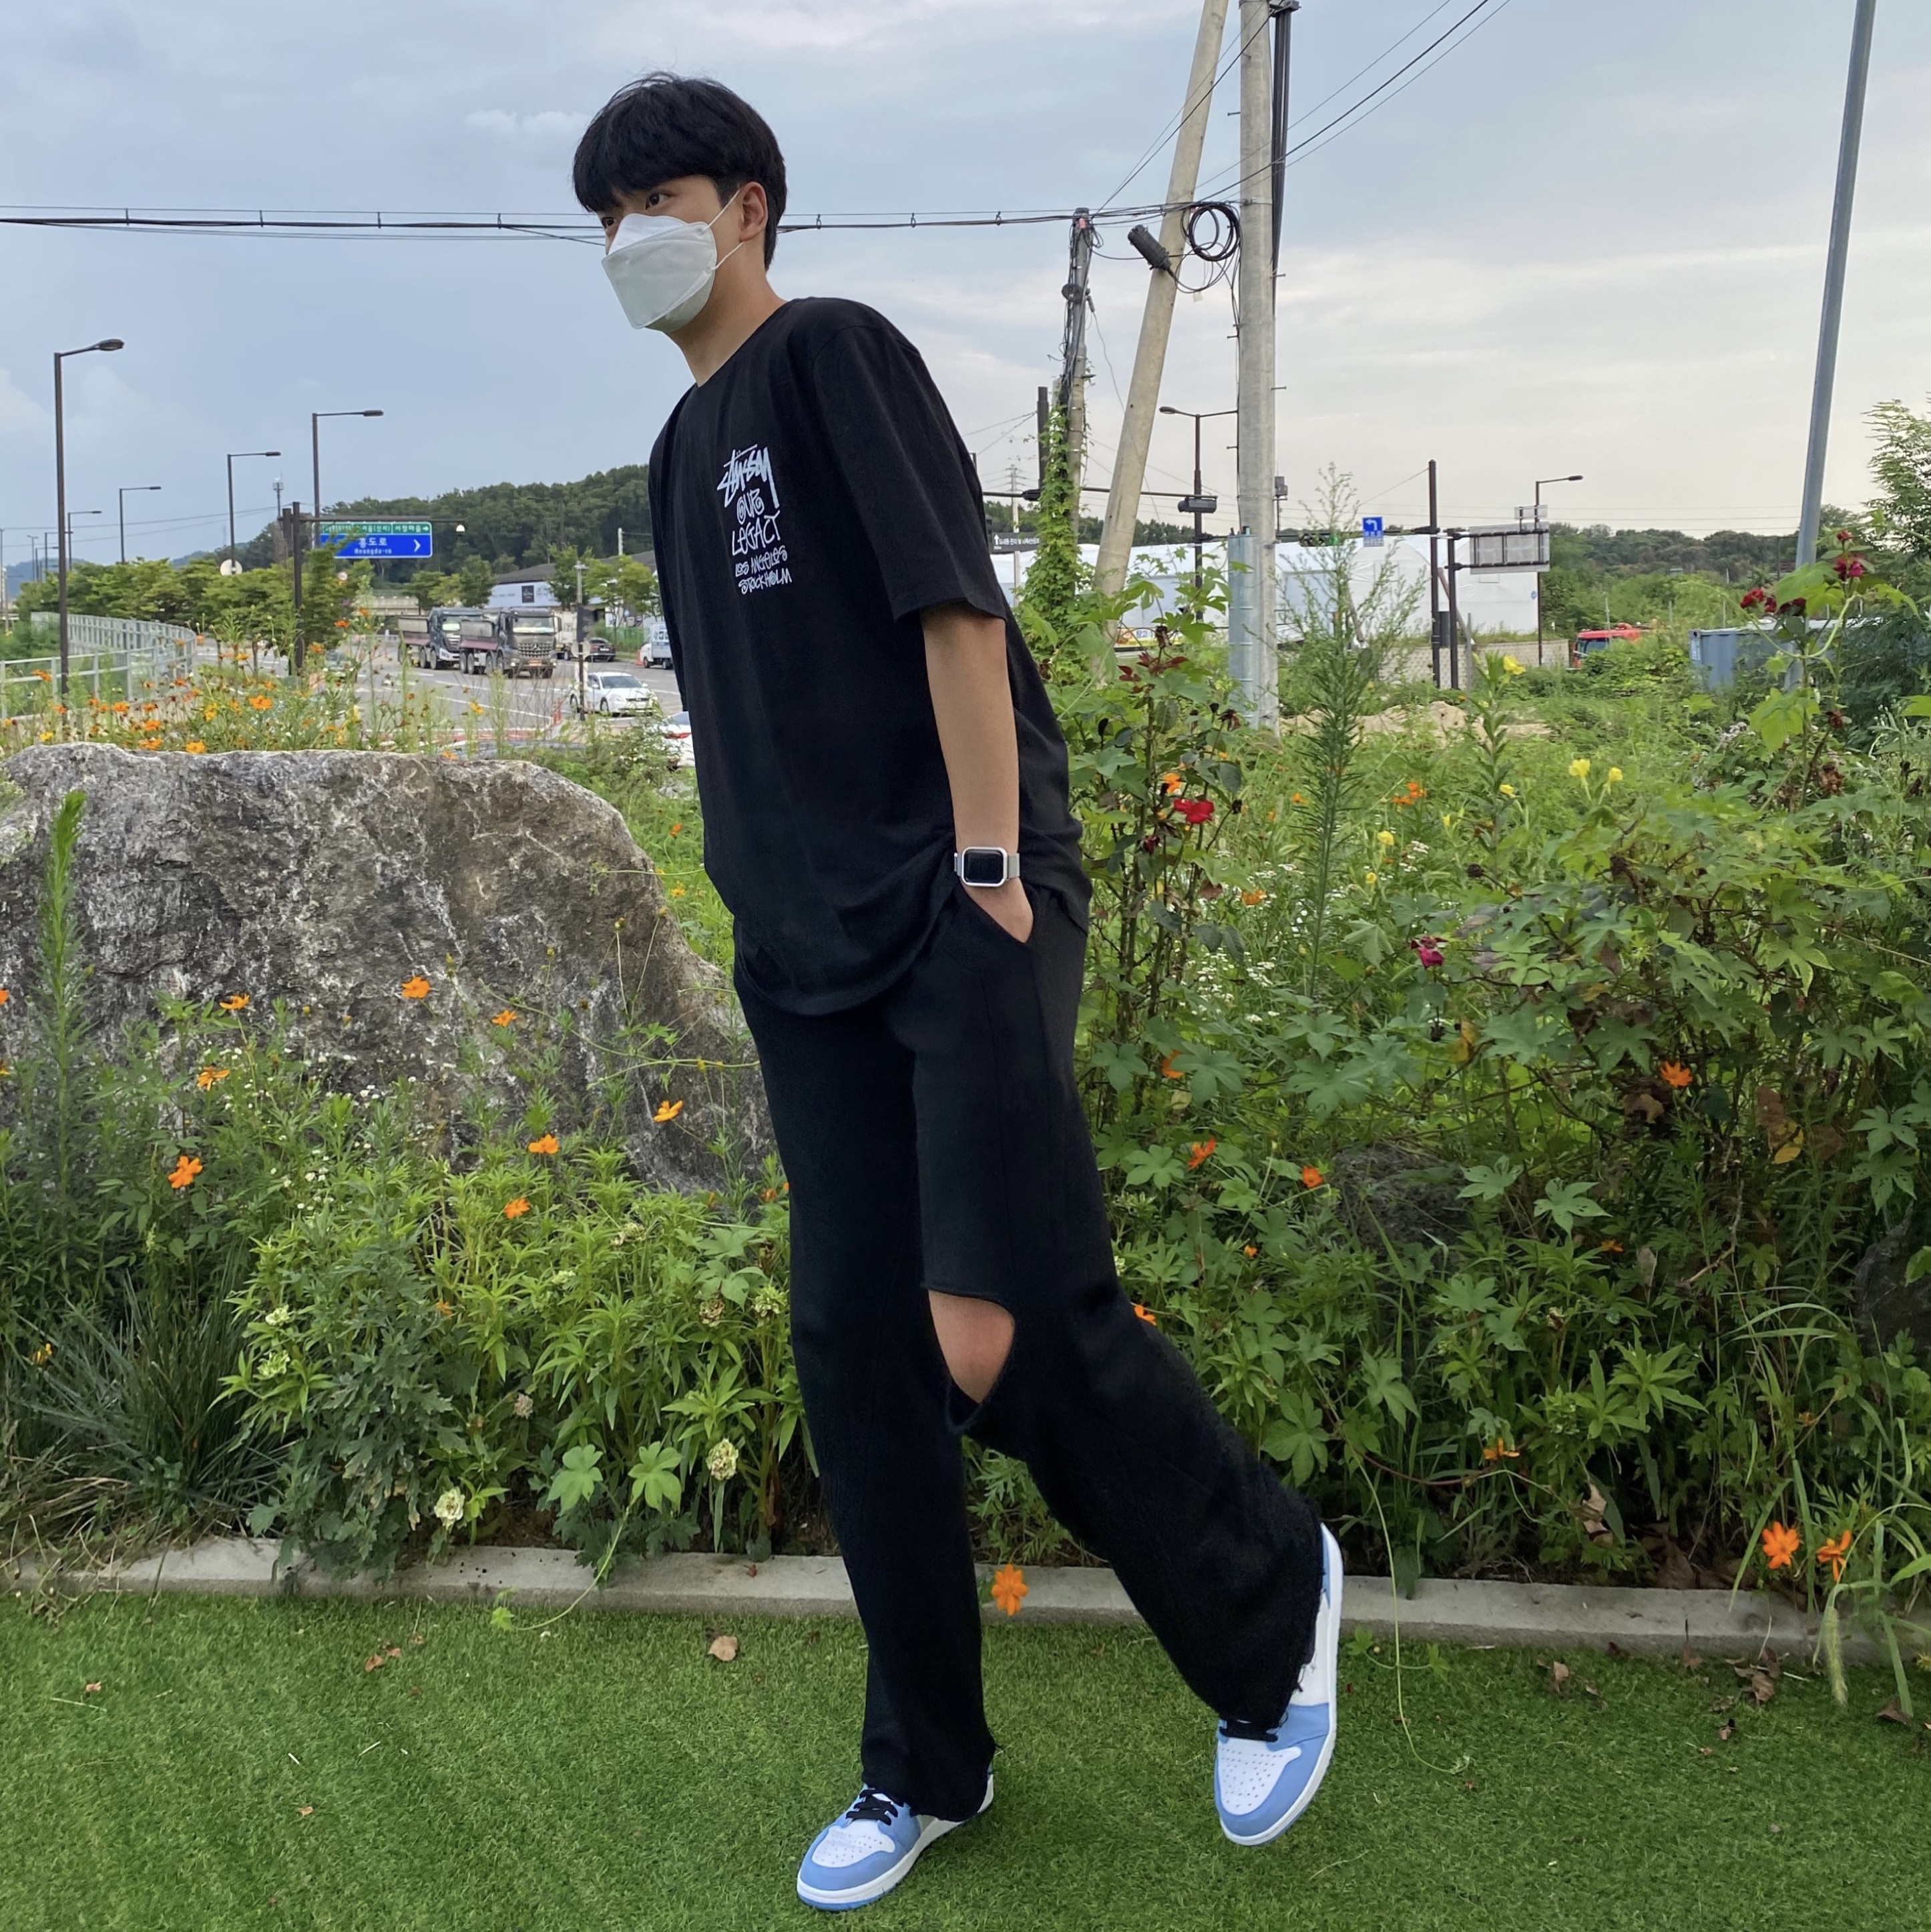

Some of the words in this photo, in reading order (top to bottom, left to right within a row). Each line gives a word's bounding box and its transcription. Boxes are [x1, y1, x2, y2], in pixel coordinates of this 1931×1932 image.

[736, 488, 765, 525] OUR
[732, 510, 781, 556] LEGACY
[735, 561, 749, 577] LOS
[750, 545, 788, 574] ANGELES
[738, 568, 793, 595] STOCKHOLM
